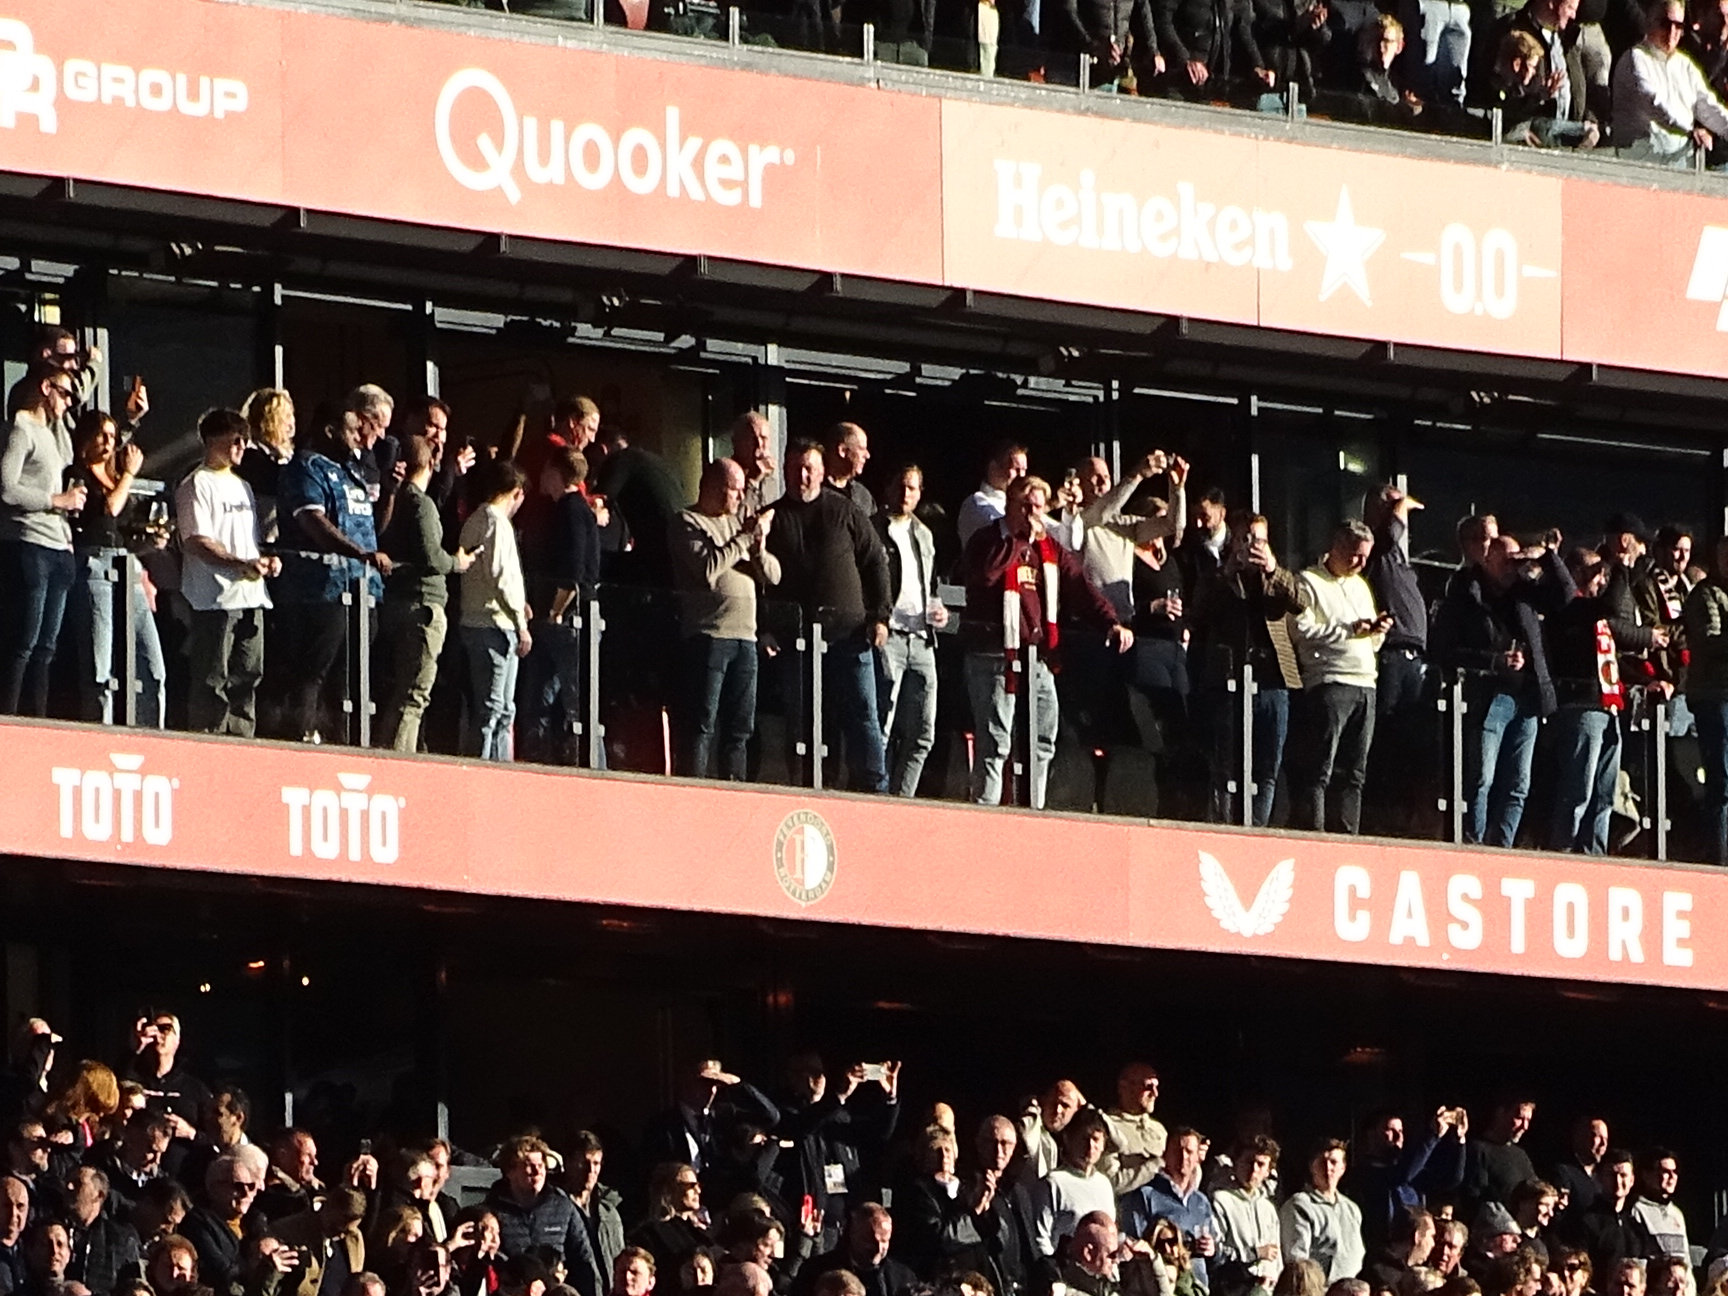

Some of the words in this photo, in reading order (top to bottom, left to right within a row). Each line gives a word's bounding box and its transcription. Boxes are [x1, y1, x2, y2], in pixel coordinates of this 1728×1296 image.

[63, 59, 250, 118] GROUP
[434, 69, 782, 208] Quooker
[993, 158, 1294, 272] Heineken
[51, 755, 174, 846] TOTO
[281, 775, 402, 864] TOTO
[1333, 864, 1694, 968] CASTORE
